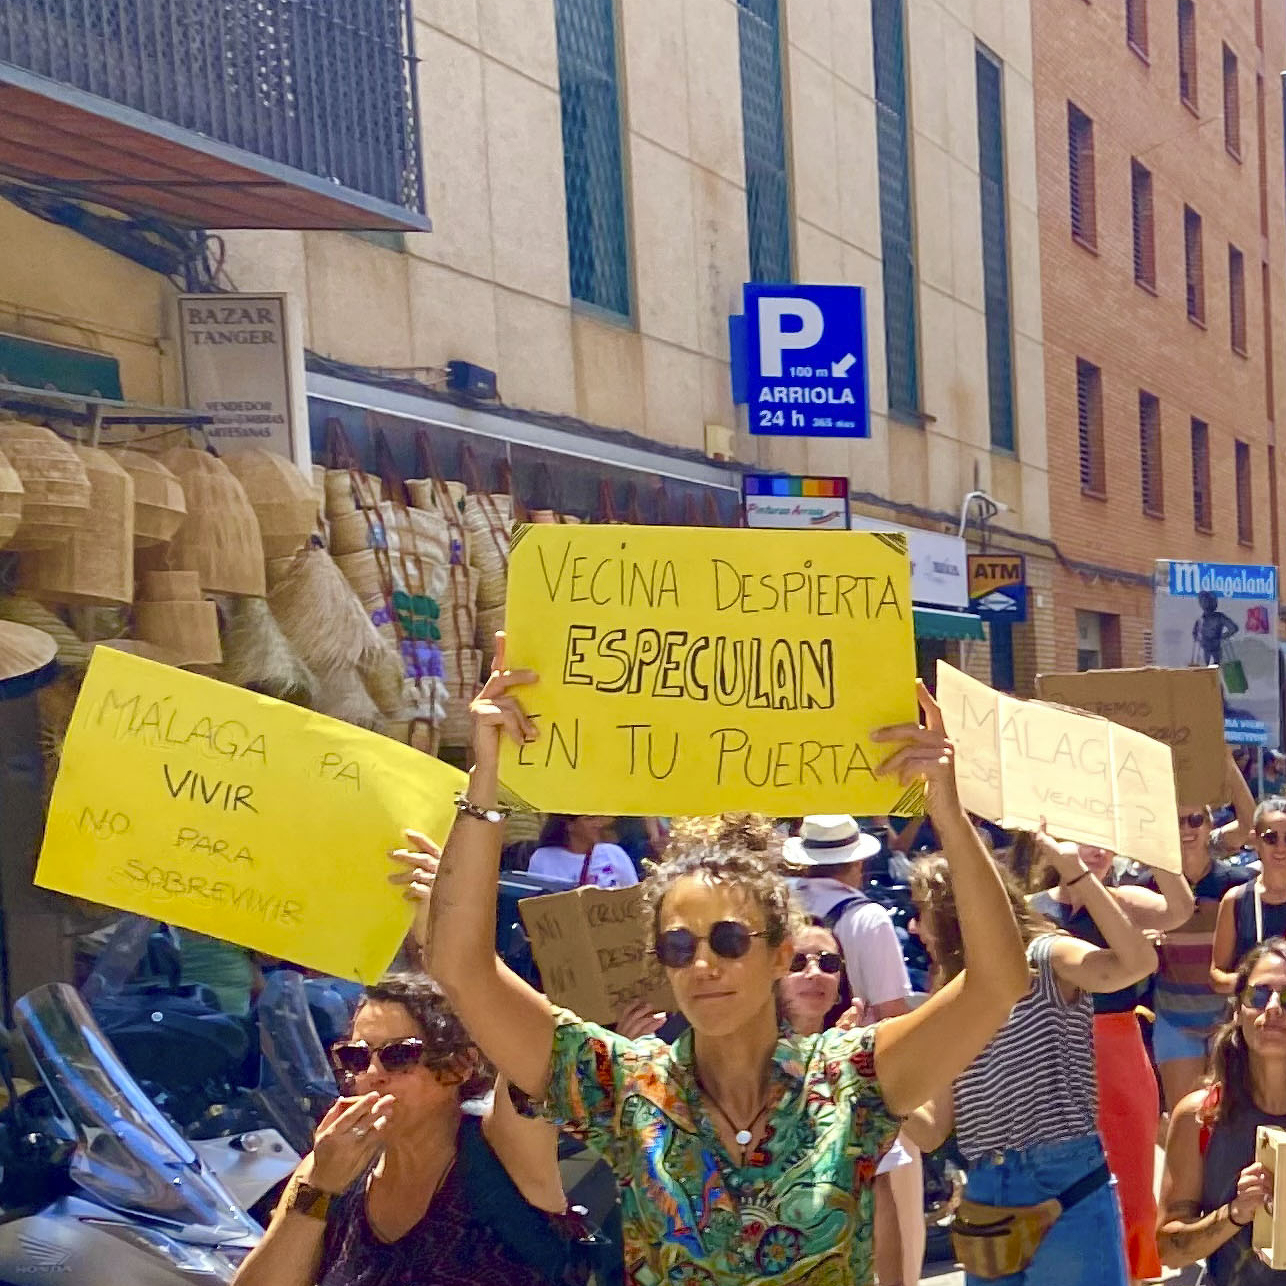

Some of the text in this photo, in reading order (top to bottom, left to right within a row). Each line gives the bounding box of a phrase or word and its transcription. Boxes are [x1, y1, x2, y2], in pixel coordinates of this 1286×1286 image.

[187, 308, 276, 324] BAZAR
[189, 330, 278, 345] TANGER
[758, 297, 825, 377] P
[758, 386, 856, 404] ARRIOLA
[759, 409, 785, 427] 24
[791, 409, 805, 427] h
[537, 541, 680, 609] VECINA
[710, 559, 903, 621] DESPIERTA
[974, 563, 1020, 580] ATM
[562, 624, 836, 711] ESPECULAN
[100, 688, 269, 765] MÁLAGA
[518, 713, 879, 788] EN TU PUERTA
[961, 693, 1151, 794] MÁLAGA
[162, 763, 259, 814] VIVIR
[78, 805, 255, 865] NO PARA
[121, 858, 304, 925] SOBREVIVIR
[15, 1265, 73, 1274] HONDA
